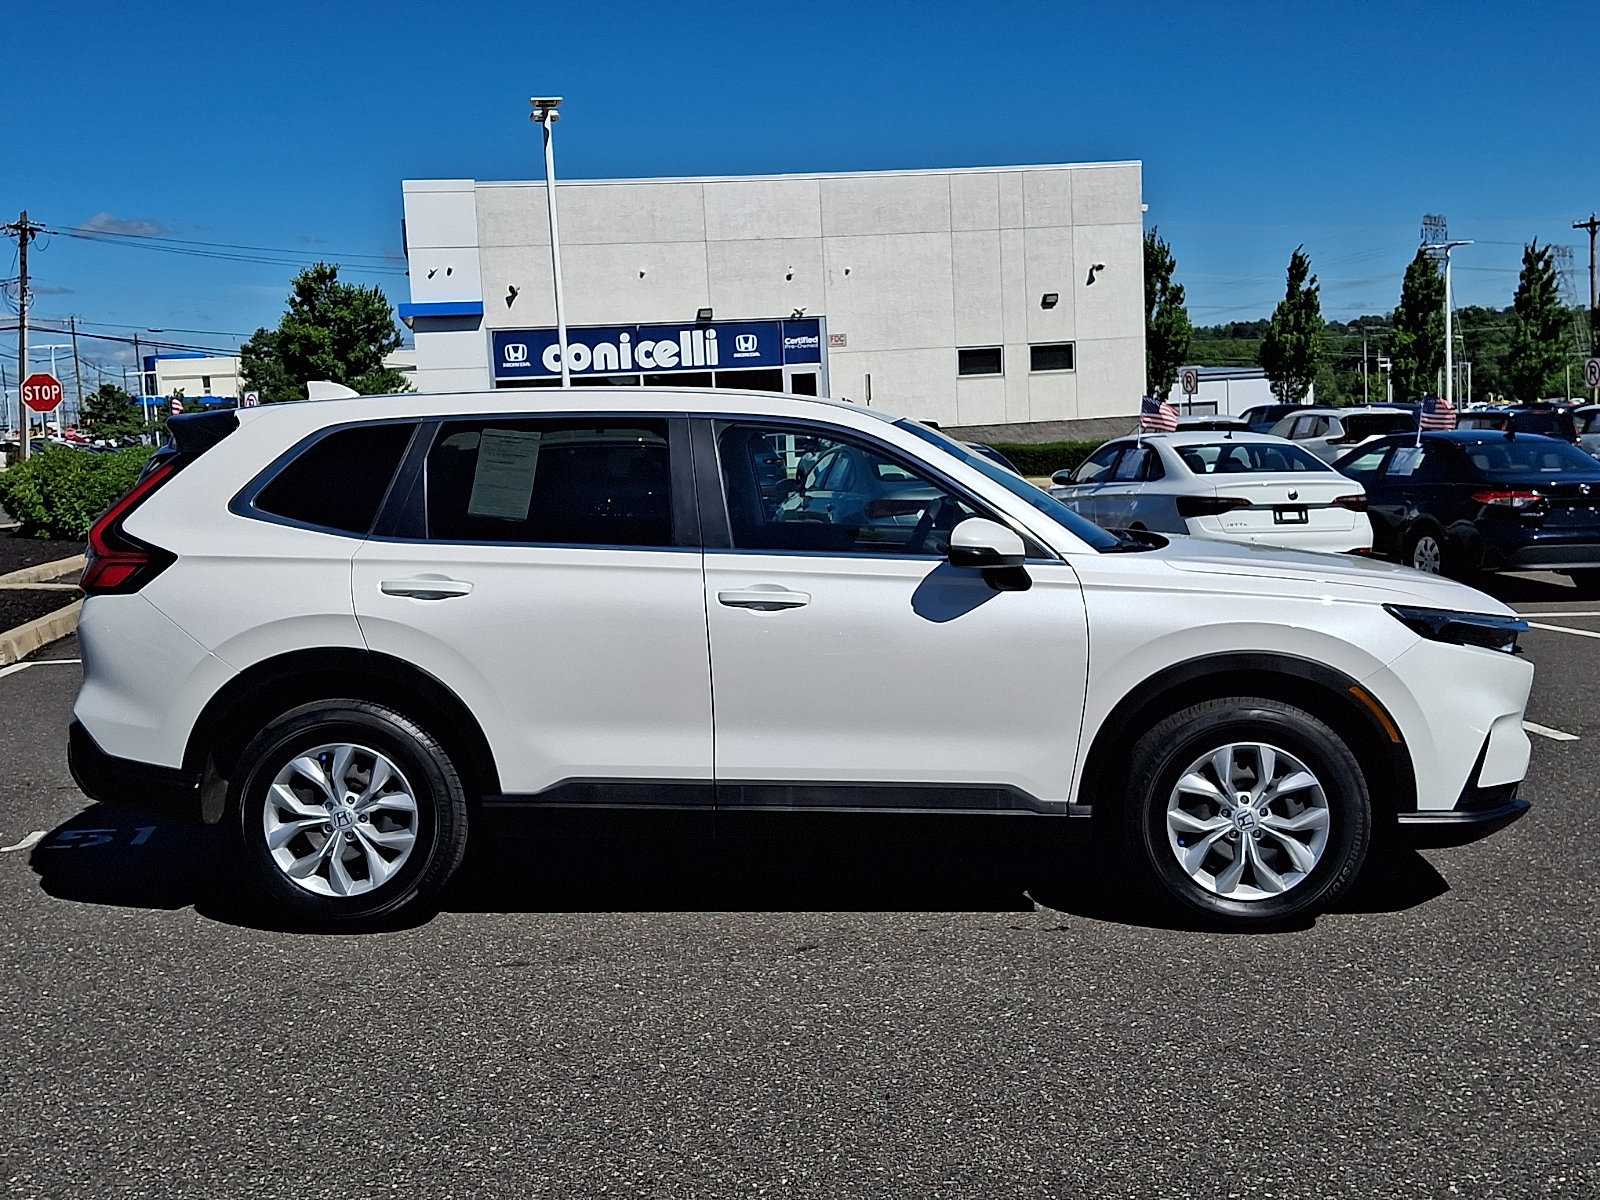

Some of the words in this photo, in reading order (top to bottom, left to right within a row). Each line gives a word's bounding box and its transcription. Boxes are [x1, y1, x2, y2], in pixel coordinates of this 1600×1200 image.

[784, 336, 818, 344] Certified
[830, 335, 844, 343] FDC
[542, 328, 719, 372] conicelli
[24, 385, 60, 401] STOP
[45, 826, 158, 849] 51
